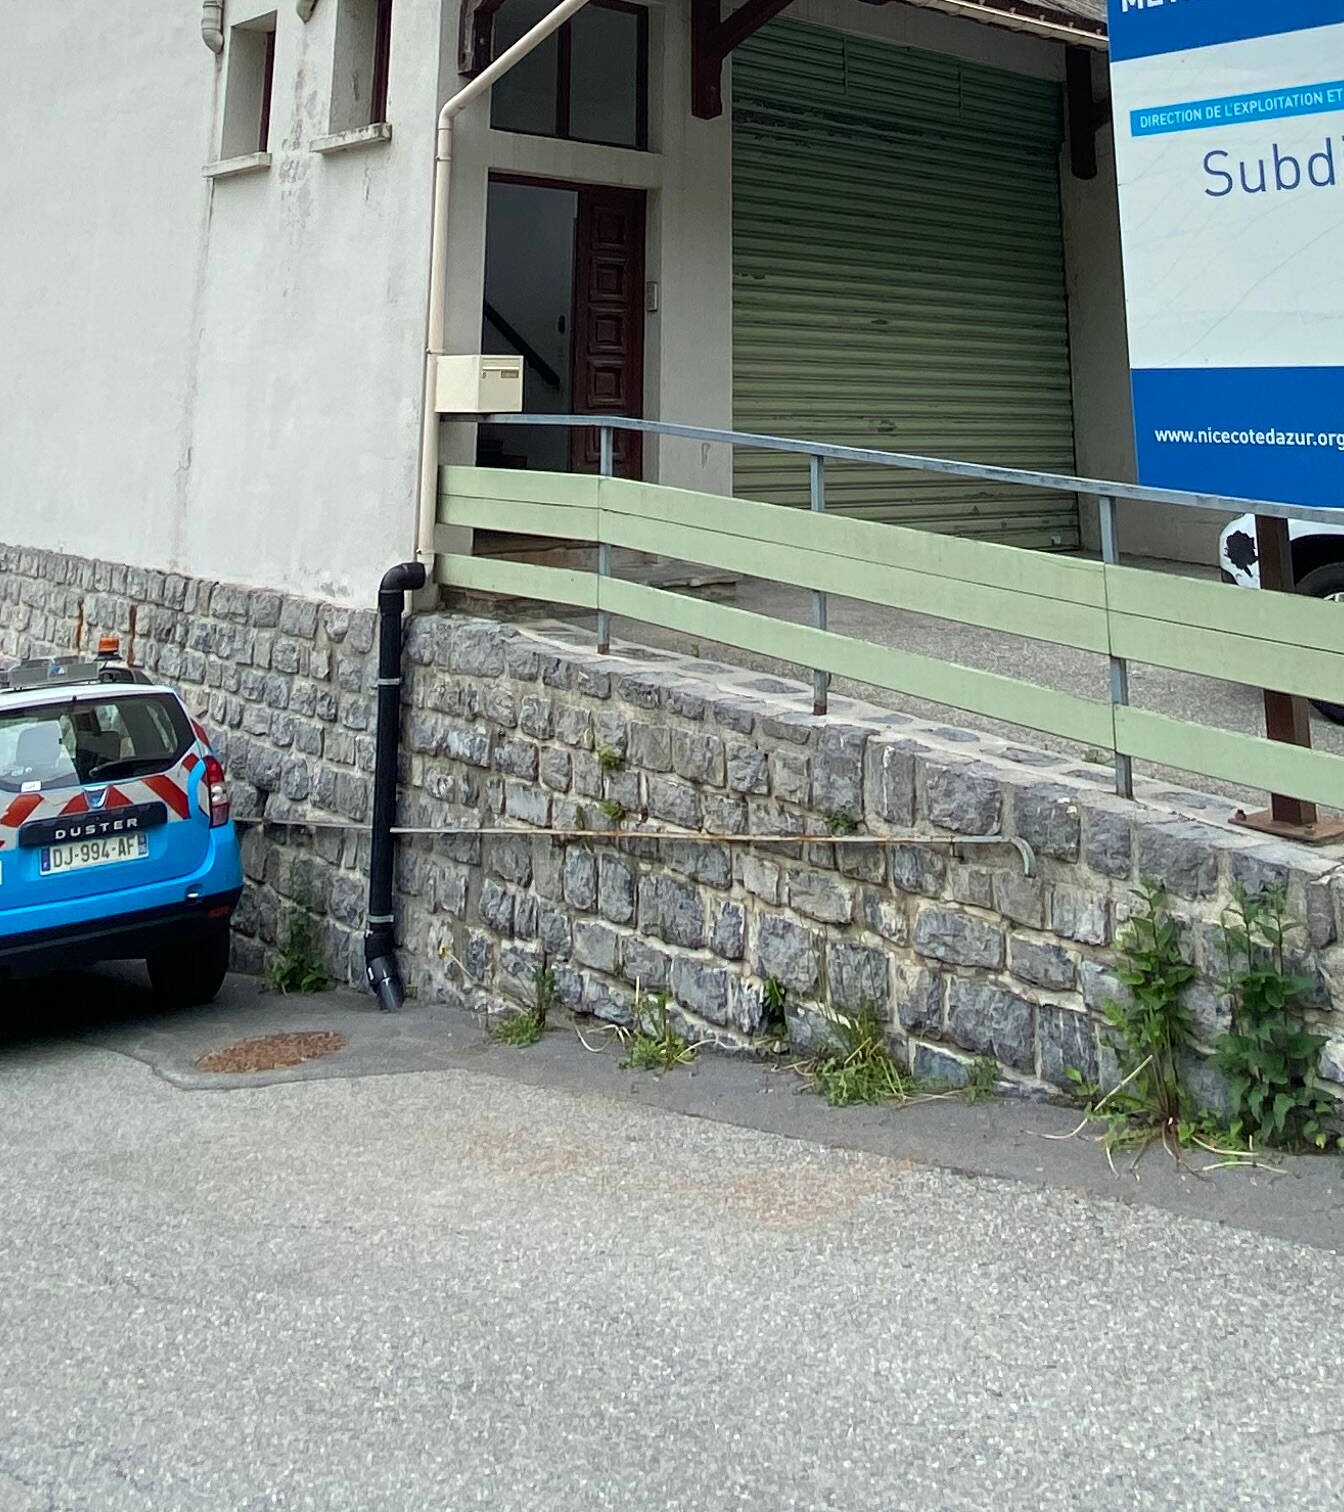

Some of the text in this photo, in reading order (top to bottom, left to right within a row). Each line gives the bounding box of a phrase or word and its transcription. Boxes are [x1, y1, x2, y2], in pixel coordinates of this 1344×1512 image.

[1140, 107, 1202, 129] DIRECTION
[1206, 104, 1222, 120] DE
[1224, 90, 1323, 117] L'EXPLOITATION
[1327, 88, 1344, 103] ET
[54, 818, 139, 840] DUSTER
[52, 837, 135, 868] DJ-994-AF
